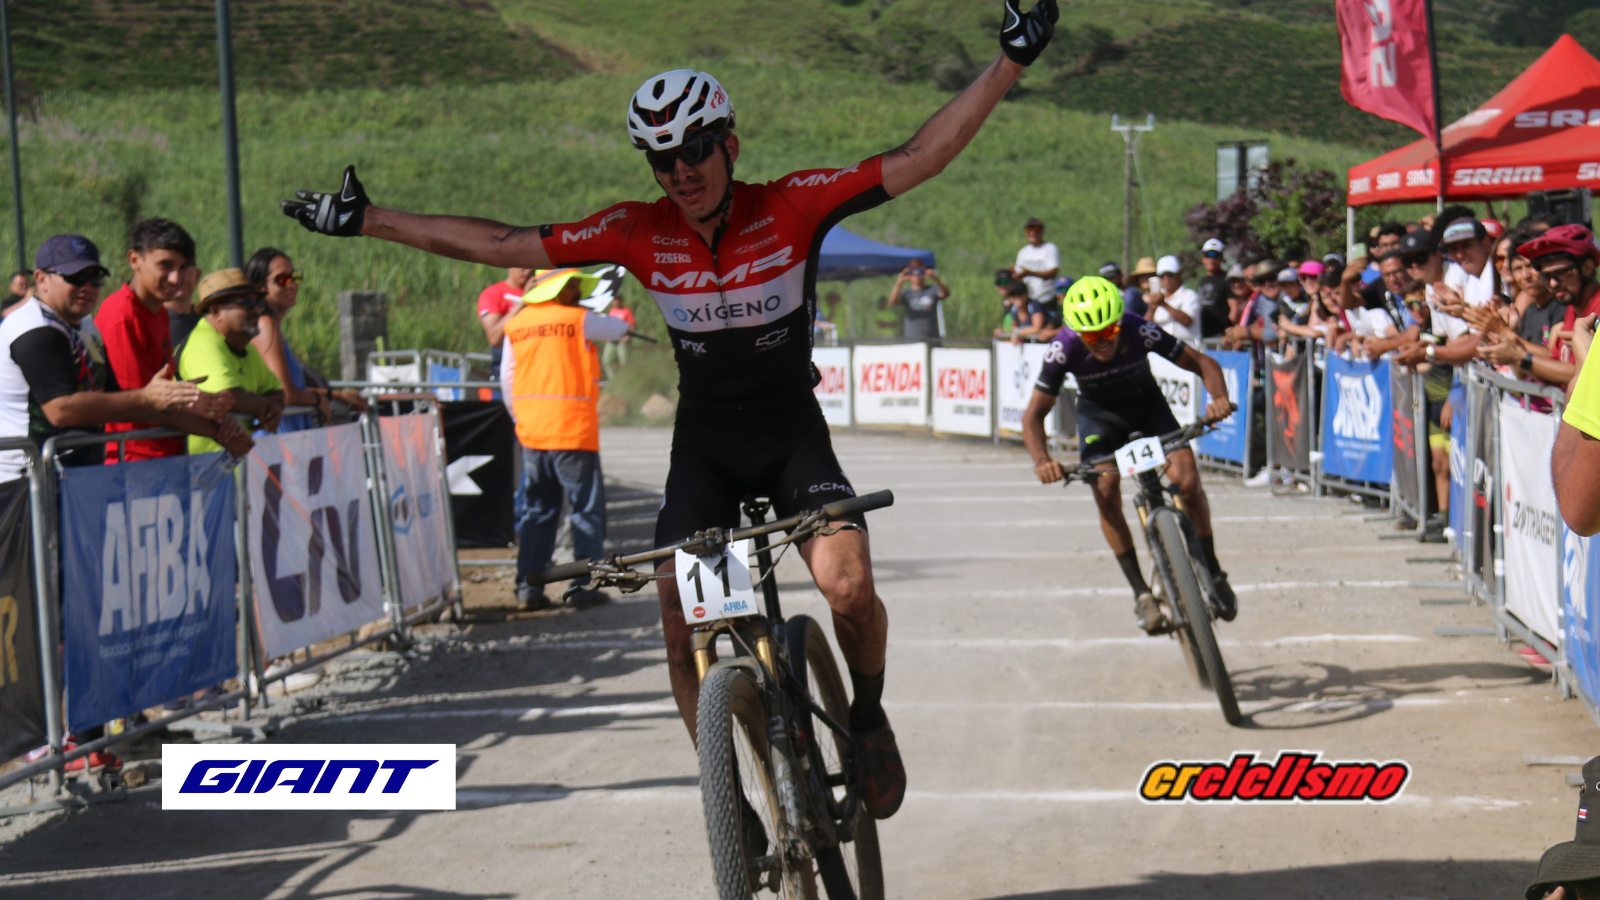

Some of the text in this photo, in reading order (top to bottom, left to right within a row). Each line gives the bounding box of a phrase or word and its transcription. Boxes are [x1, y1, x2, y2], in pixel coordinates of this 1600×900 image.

[787, 162, 860, 187] MMR
[1452, 166, 1542, 186] SRAM
[562, 208, 627, 244] MMR
[651, 245, 793, 288] MMR
[653, 252, 692, 263] 226ERS
[674, 295, 781, 323] OXÍGENO
[680, 339, 707, 353] FOX
[860, 362, 922, 392] KENDA
[936, 367, 987, 400] KENDA
[1125, 443, 1153, 465] 14
[262, 456, 361, 623] Liv
[686, 555, 731, 603] 11
